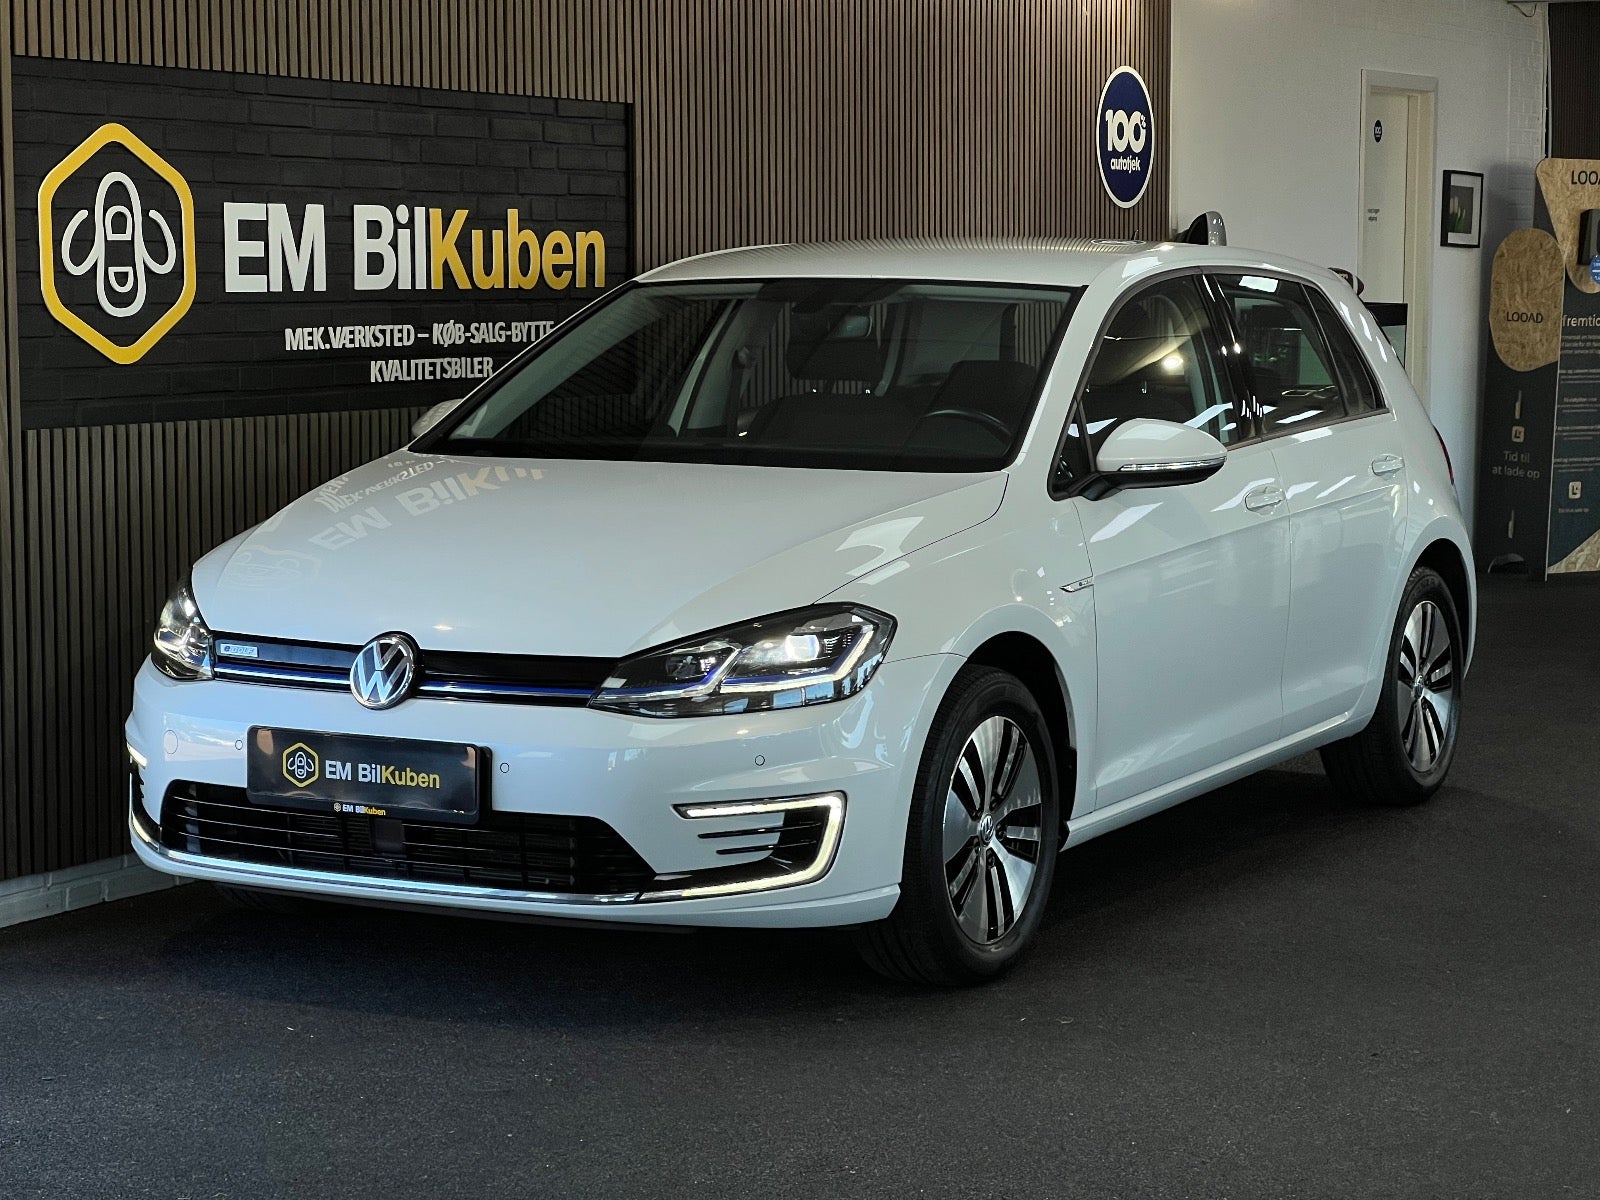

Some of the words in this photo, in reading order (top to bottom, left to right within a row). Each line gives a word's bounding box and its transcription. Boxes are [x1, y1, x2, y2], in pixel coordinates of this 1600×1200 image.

[1110, 155, 1141, 174] autotjek
[223, 202, 327, 293] EM
[353, 203, 606, 292] BilKuben
[1506, 311, 1544, 324] LOOAD
[284, 324, 415, 351] MEK.VÆRKSTED
[370, 356, 494, 383] KVALITETSBILER
[1504, 451, 1518, 462] Tid
[1520, 452, 1530, 463] til
[1491, 466, 1503, 475] at
[1504, 465, 1525, 477] lade
[1527, 470, 1541, 480] op
[325, 759, 352, 782] EM
[357, 763, 441, 789] BilKuben
[342, 803, 354, 813] EM
